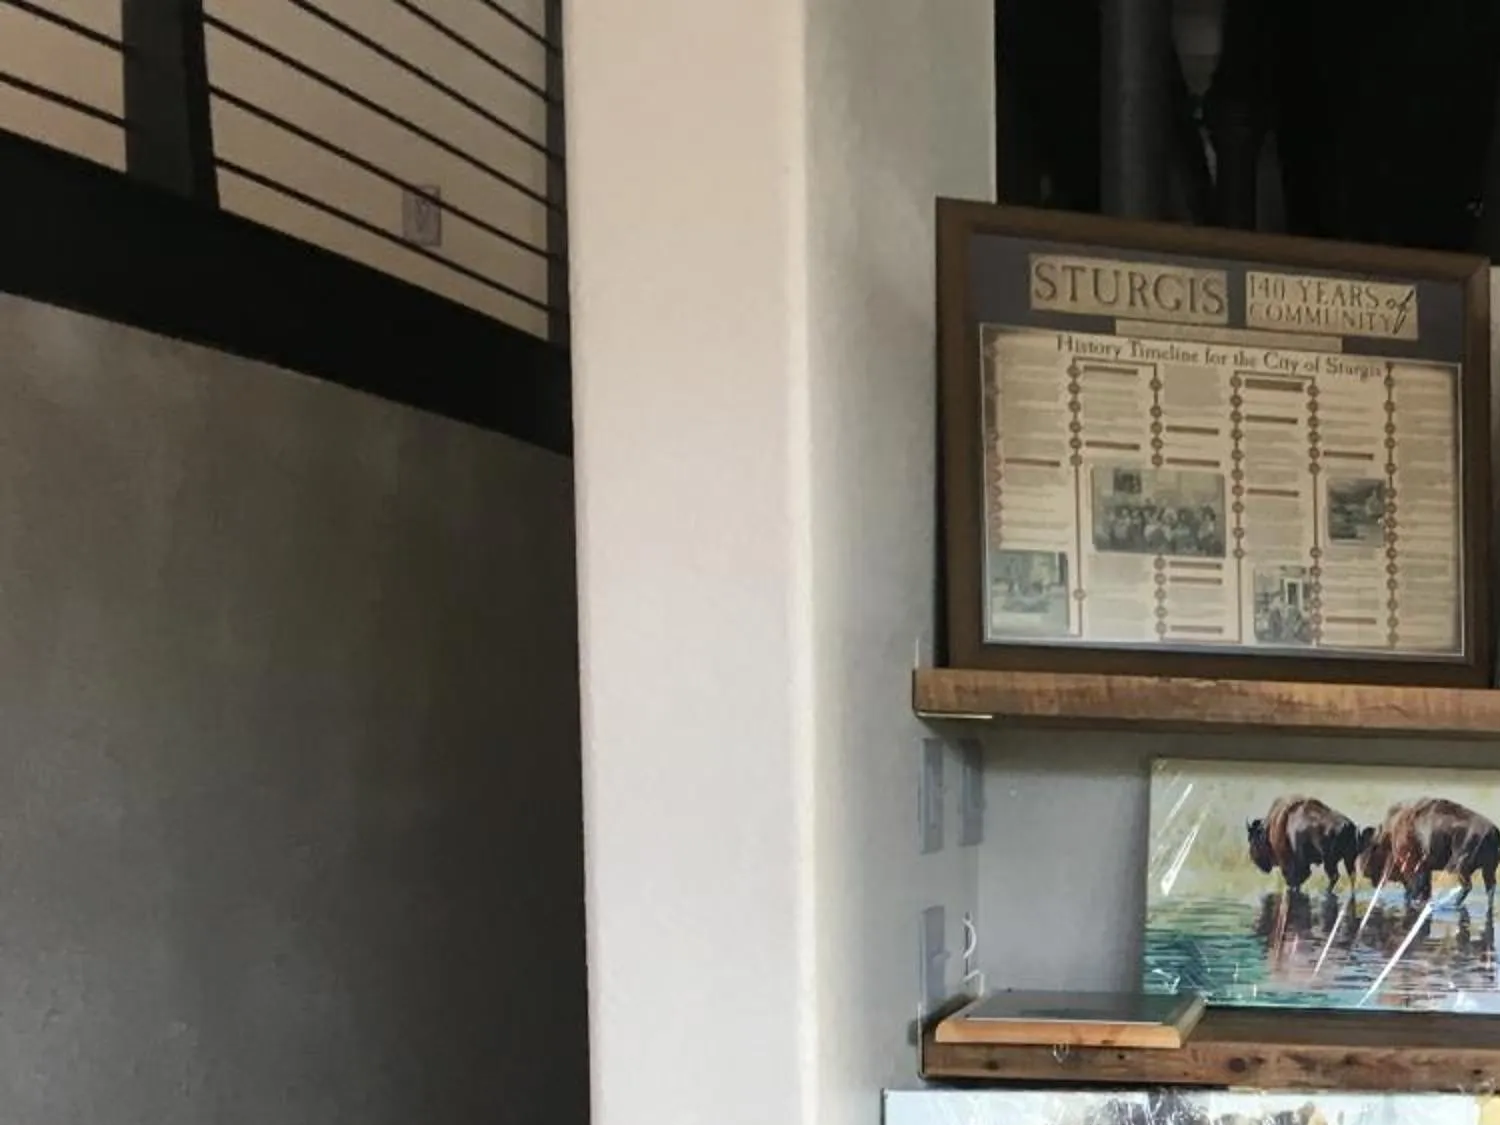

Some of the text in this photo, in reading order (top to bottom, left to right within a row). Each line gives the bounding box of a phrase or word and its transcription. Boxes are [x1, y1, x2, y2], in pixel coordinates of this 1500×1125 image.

[1034, 261, 1226, 316] STURGIS
[1249, 274, 1415, 334] 140 YEARS of
[1249, 300, 1391, 332] COMMUNITY
[1056, 334, 1382, 383] History Timeline for the City of Sturgis
